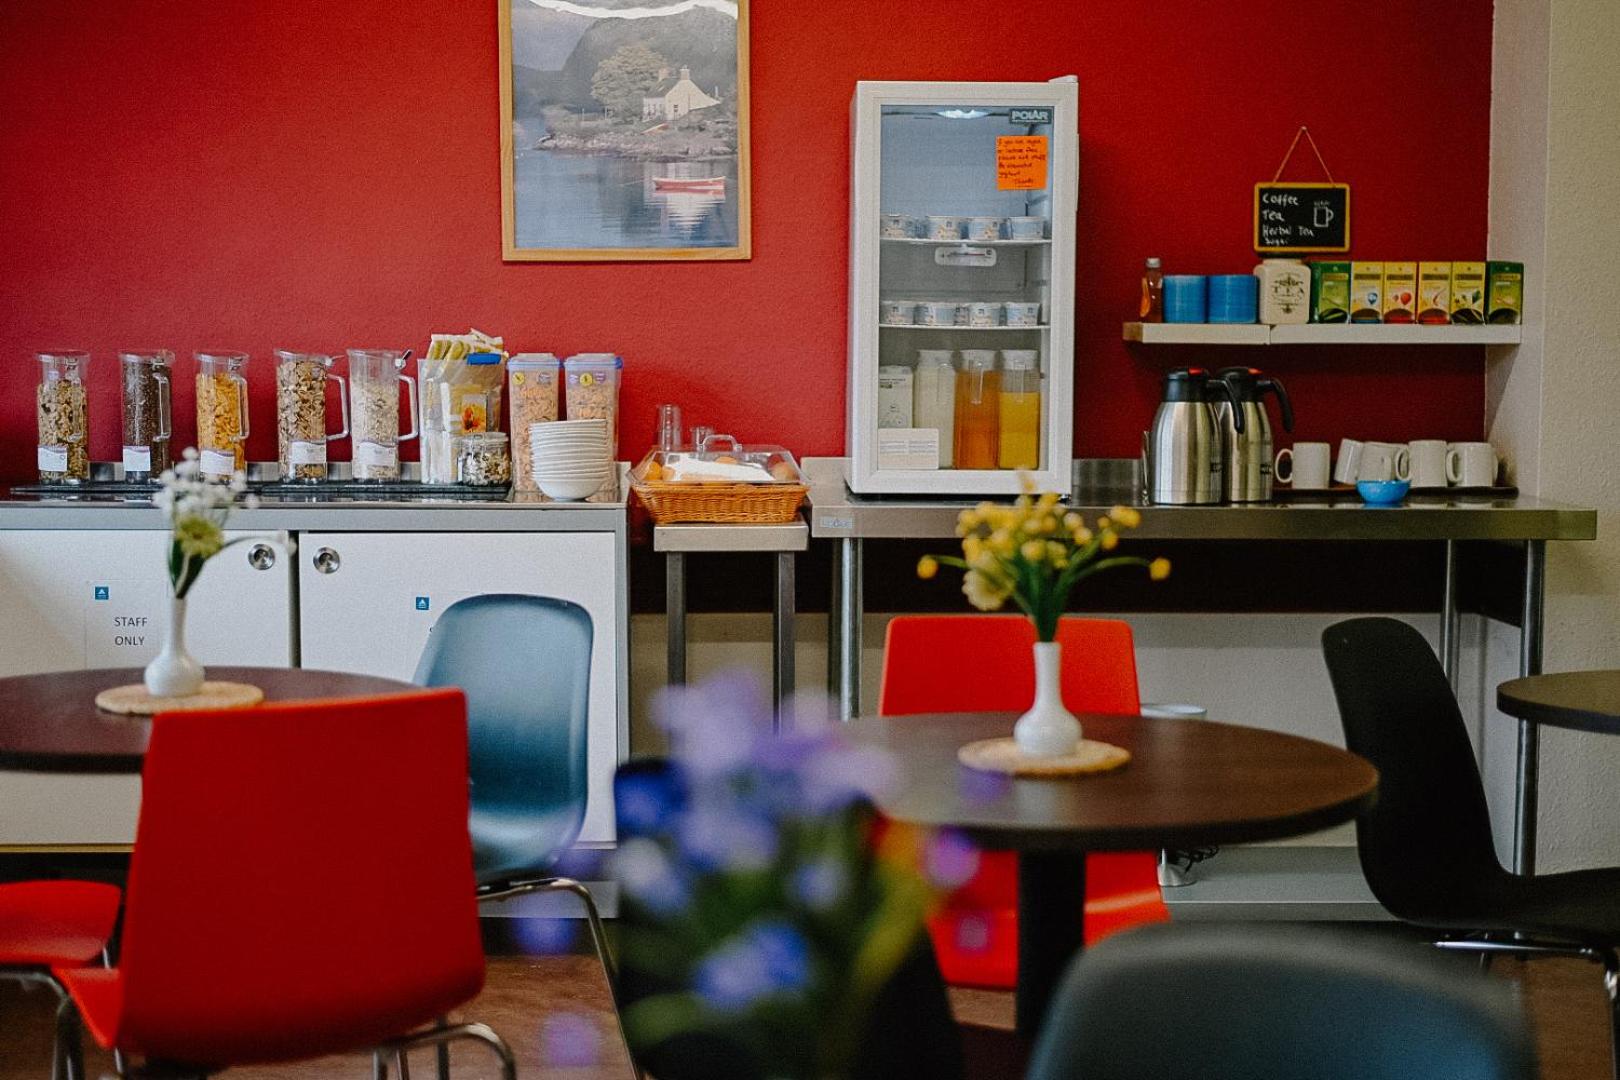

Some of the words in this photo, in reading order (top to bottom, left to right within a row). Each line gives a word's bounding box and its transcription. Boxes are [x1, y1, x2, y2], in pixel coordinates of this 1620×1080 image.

[1011, 110, 1048, 120] POLAR
[1262, 193, 1299, 207] Coffee
[1262, 209, 1285, 222] Tea
[1298, 225, 1315, 237] Tea
[114, 617, 148, 627] STAFF
[114, 635, 145, 646] ONLY
